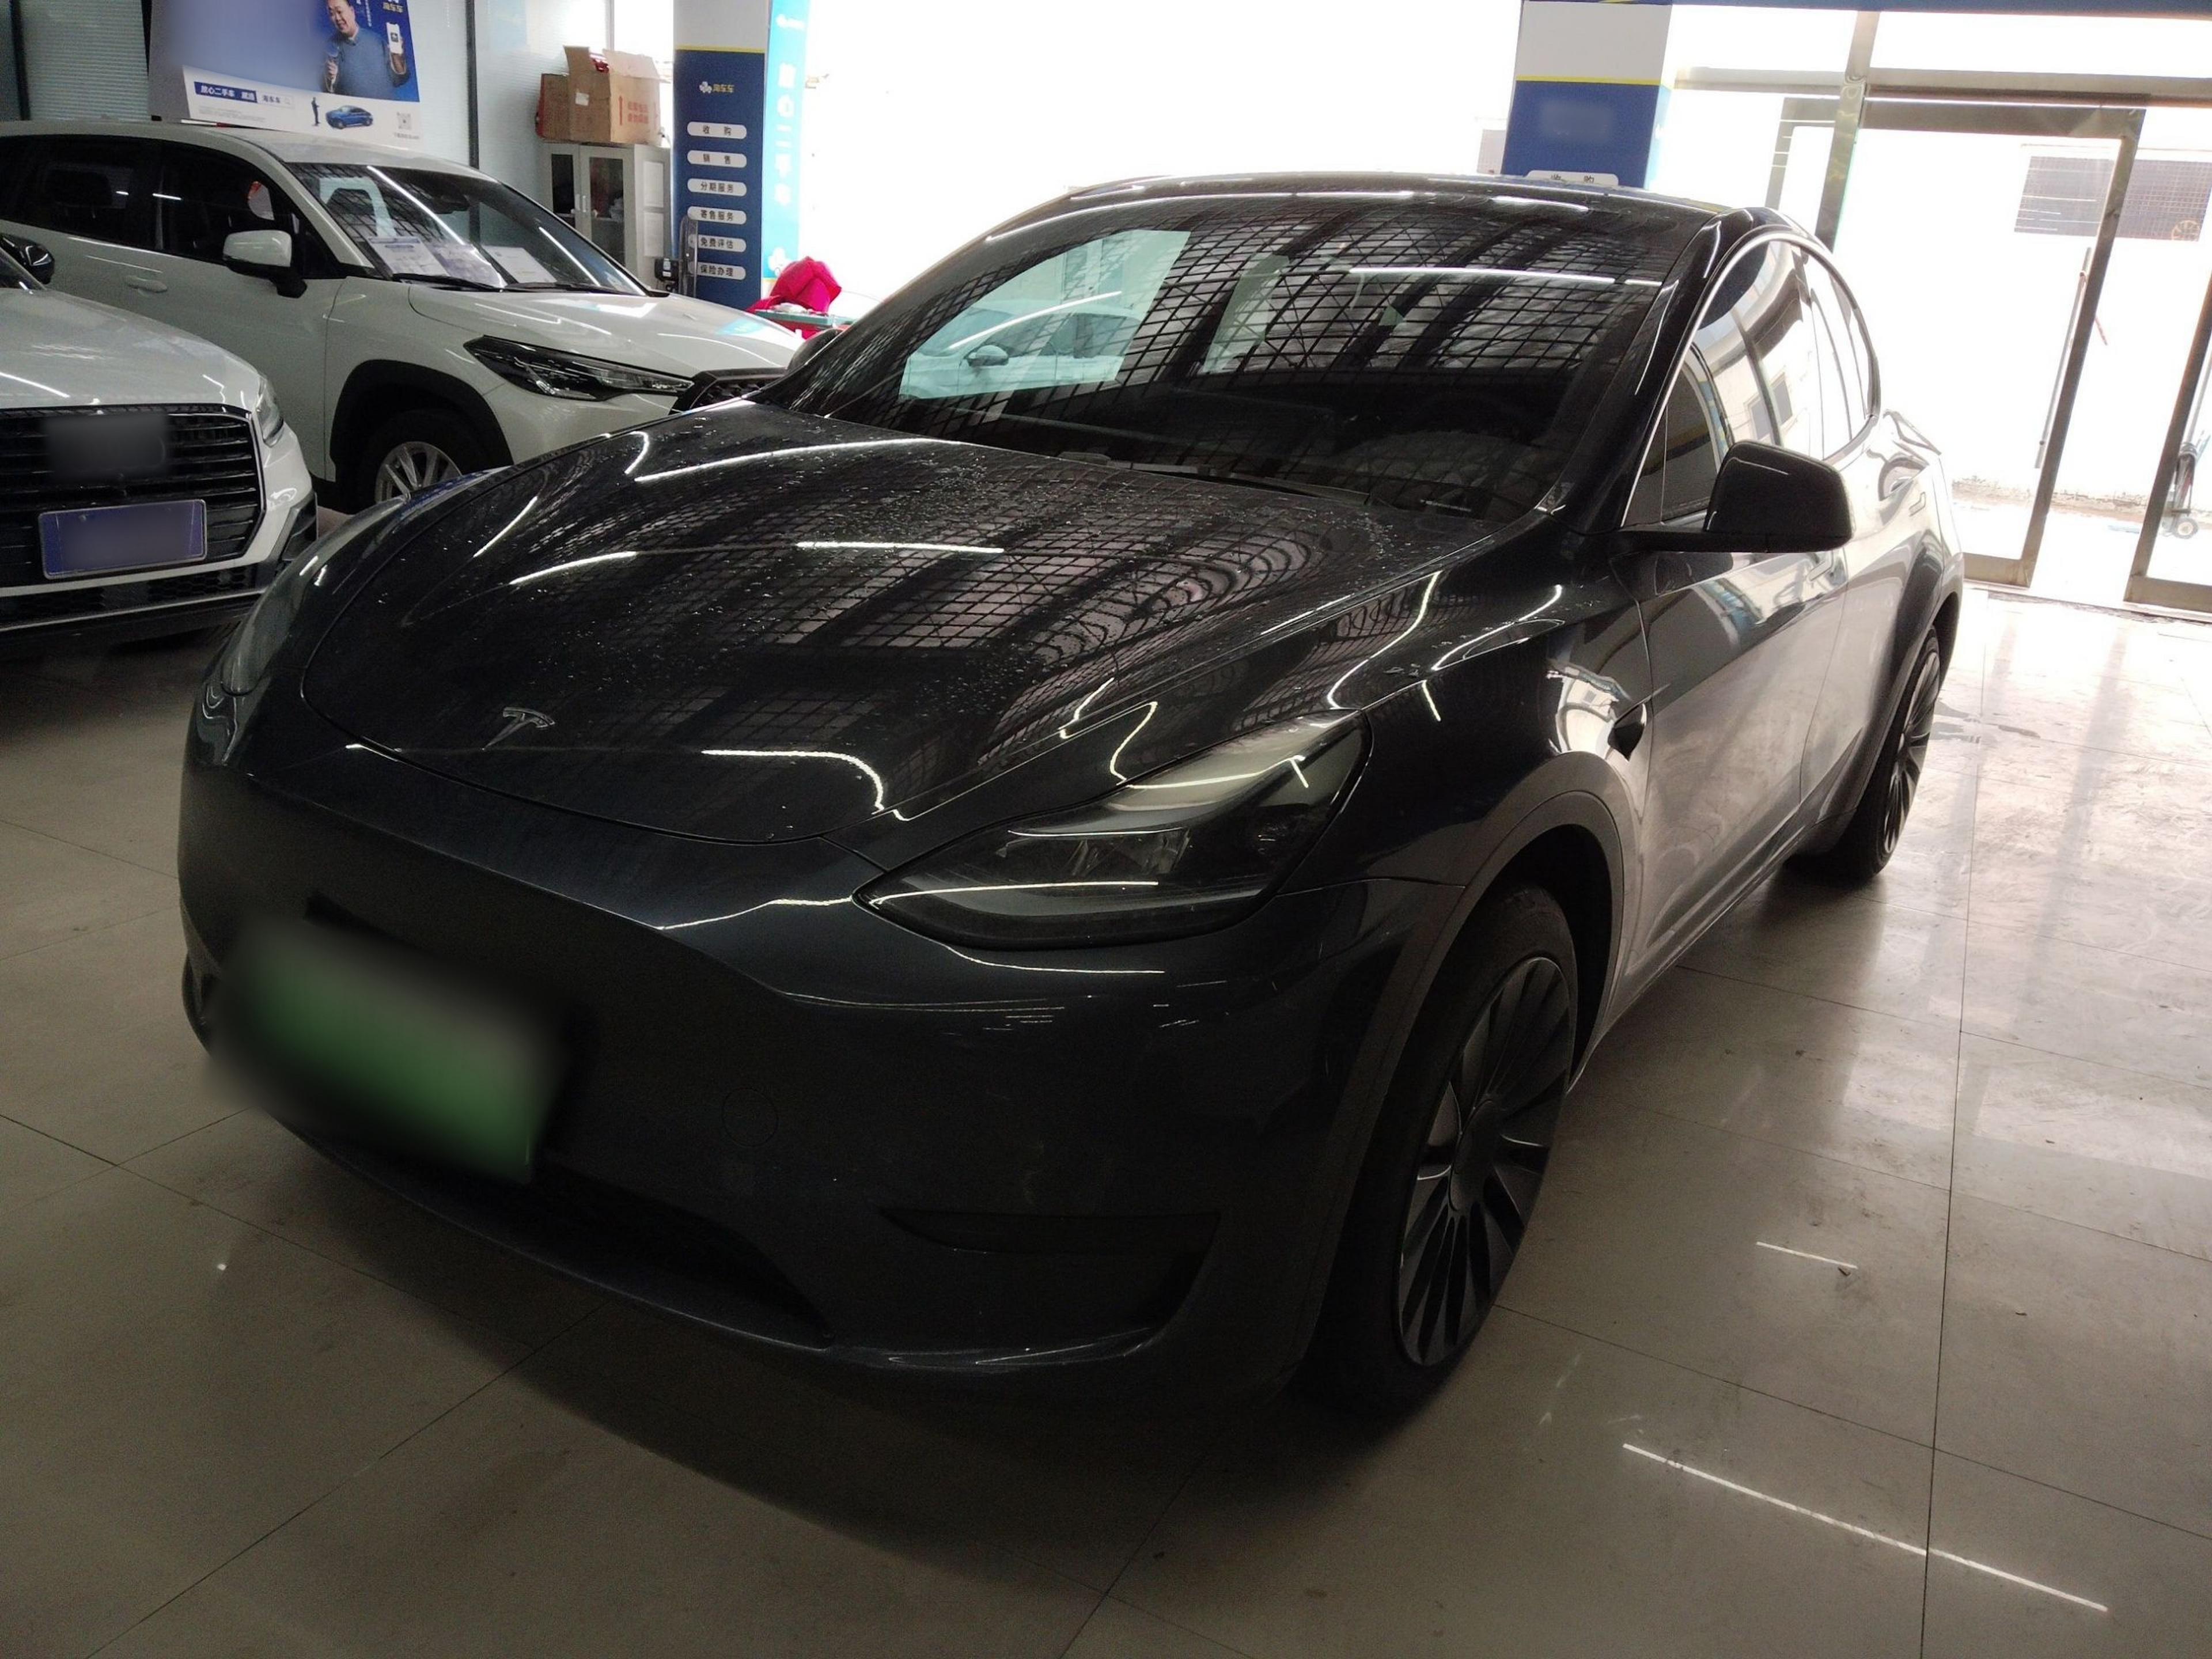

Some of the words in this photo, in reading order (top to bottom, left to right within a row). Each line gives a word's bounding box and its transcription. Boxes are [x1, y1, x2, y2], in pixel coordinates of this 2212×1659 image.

[700, 181, 733, 193] 分期服务
[700, 210, 733, 221] 寄售服务
[700, 237, 733, 249] 免费评估
[700, 265, 733, 276] 保险办理
